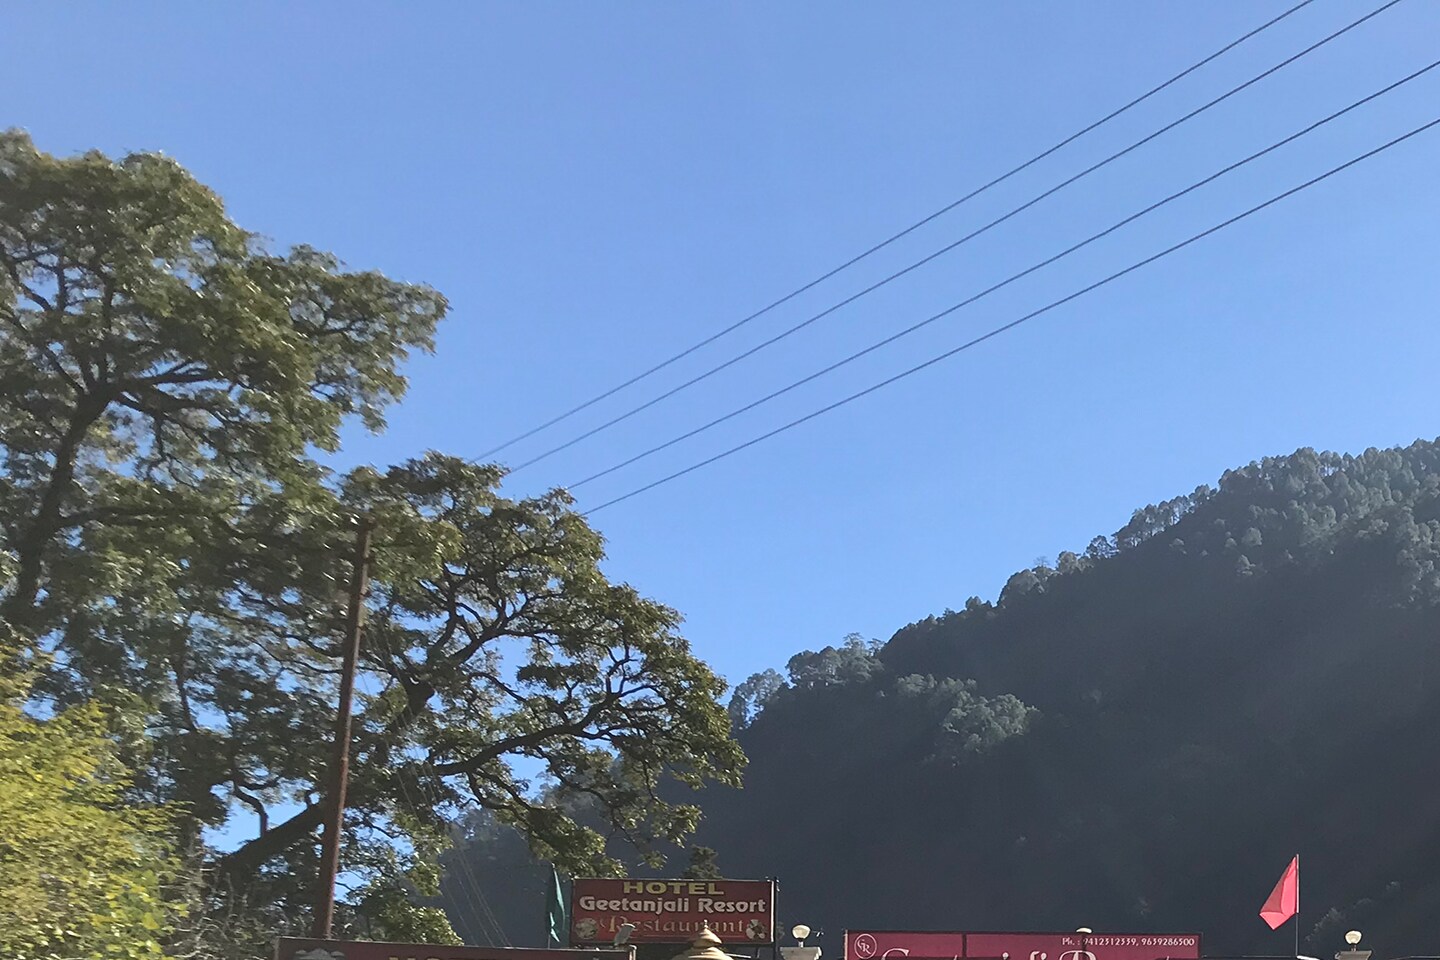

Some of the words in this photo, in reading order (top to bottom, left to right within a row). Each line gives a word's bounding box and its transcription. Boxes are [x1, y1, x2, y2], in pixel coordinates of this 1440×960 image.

[623, 881, 725, 895] HOTEL
[579, 896, 689, 915] Geetanjali
[698, 898, 766, 914] Resort
